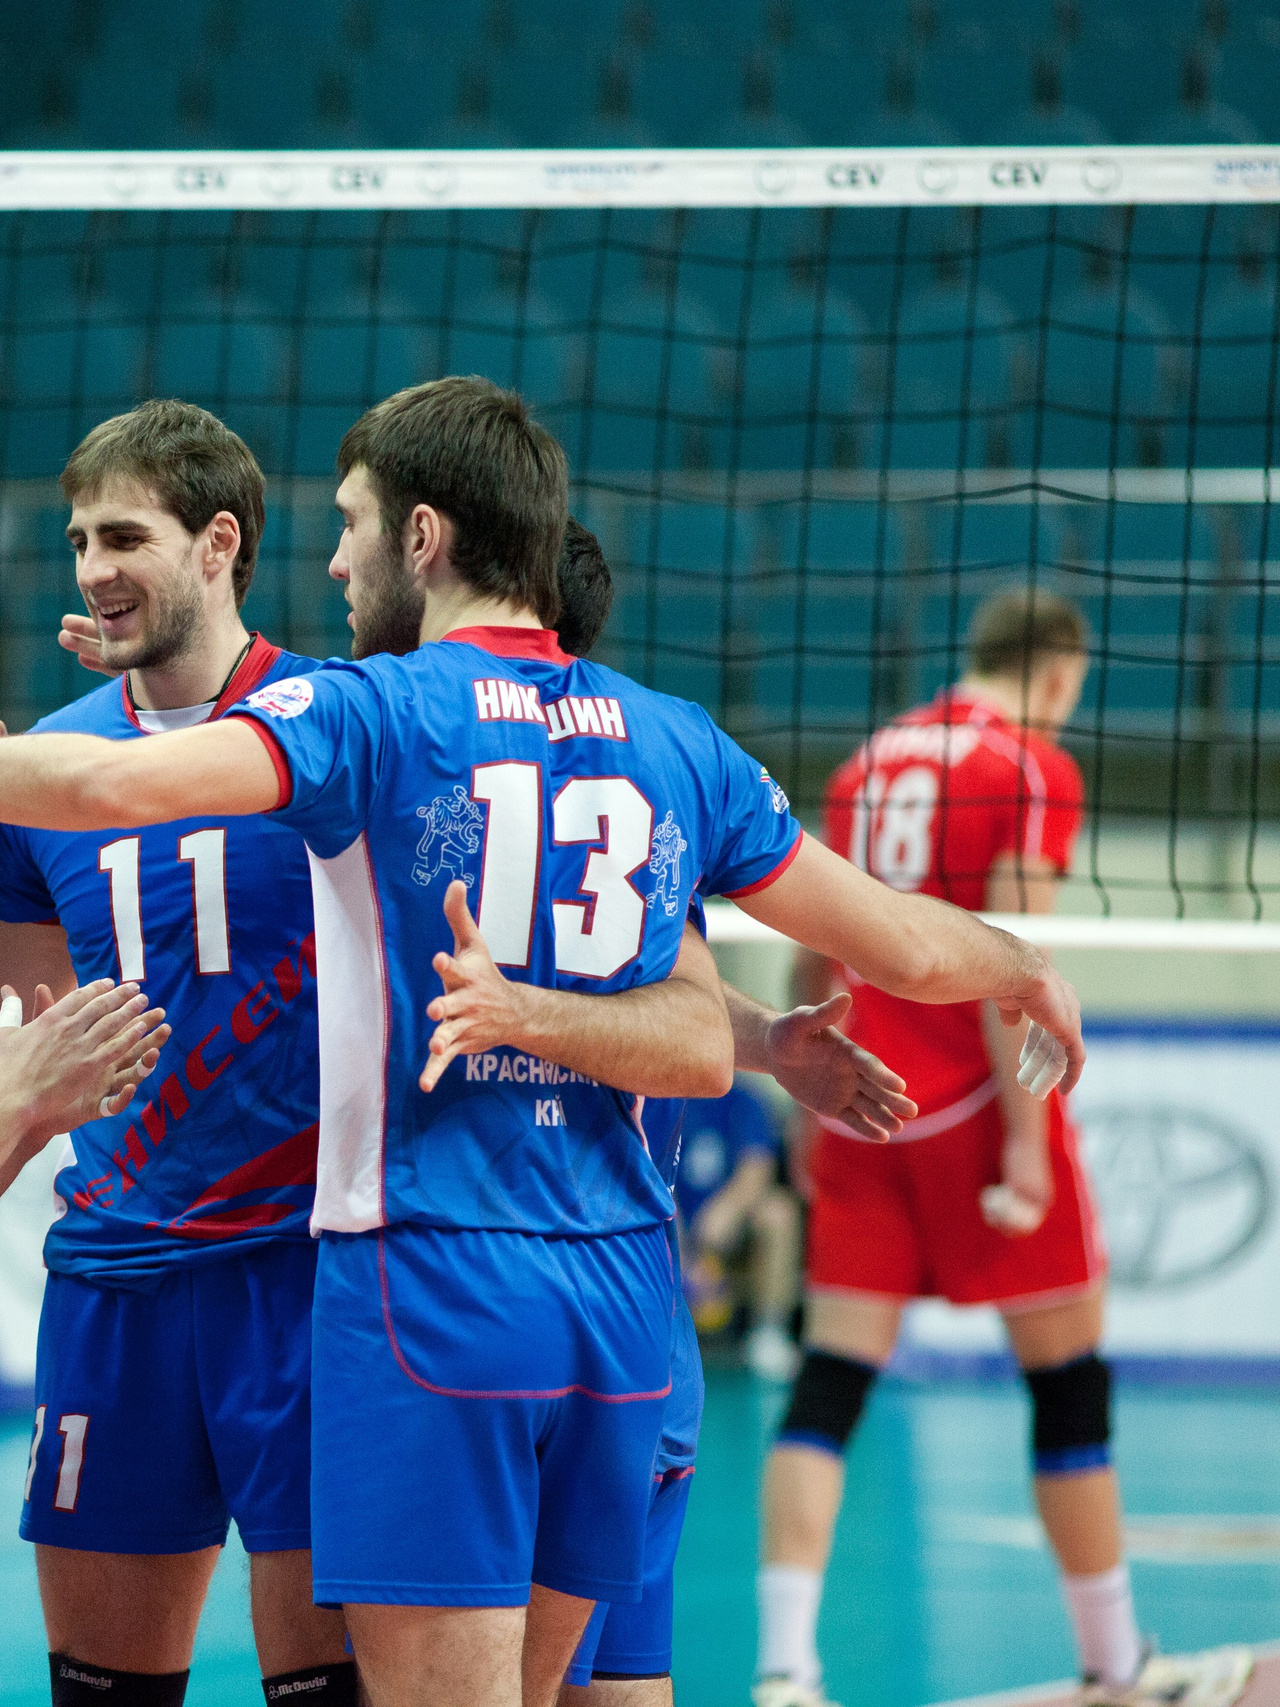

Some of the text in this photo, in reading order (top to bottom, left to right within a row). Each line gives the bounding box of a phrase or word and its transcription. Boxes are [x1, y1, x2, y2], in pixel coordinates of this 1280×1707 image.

[176, 165, 384, 192] CEV CEV
[825, 160, 1047, 189] CEV CEV
[849, 764, 940, 892] 18
[98, 827, 232, 982] 11
[471, 759, 655, 981] 13
[278, 1675, 328, 1697] McDavid
